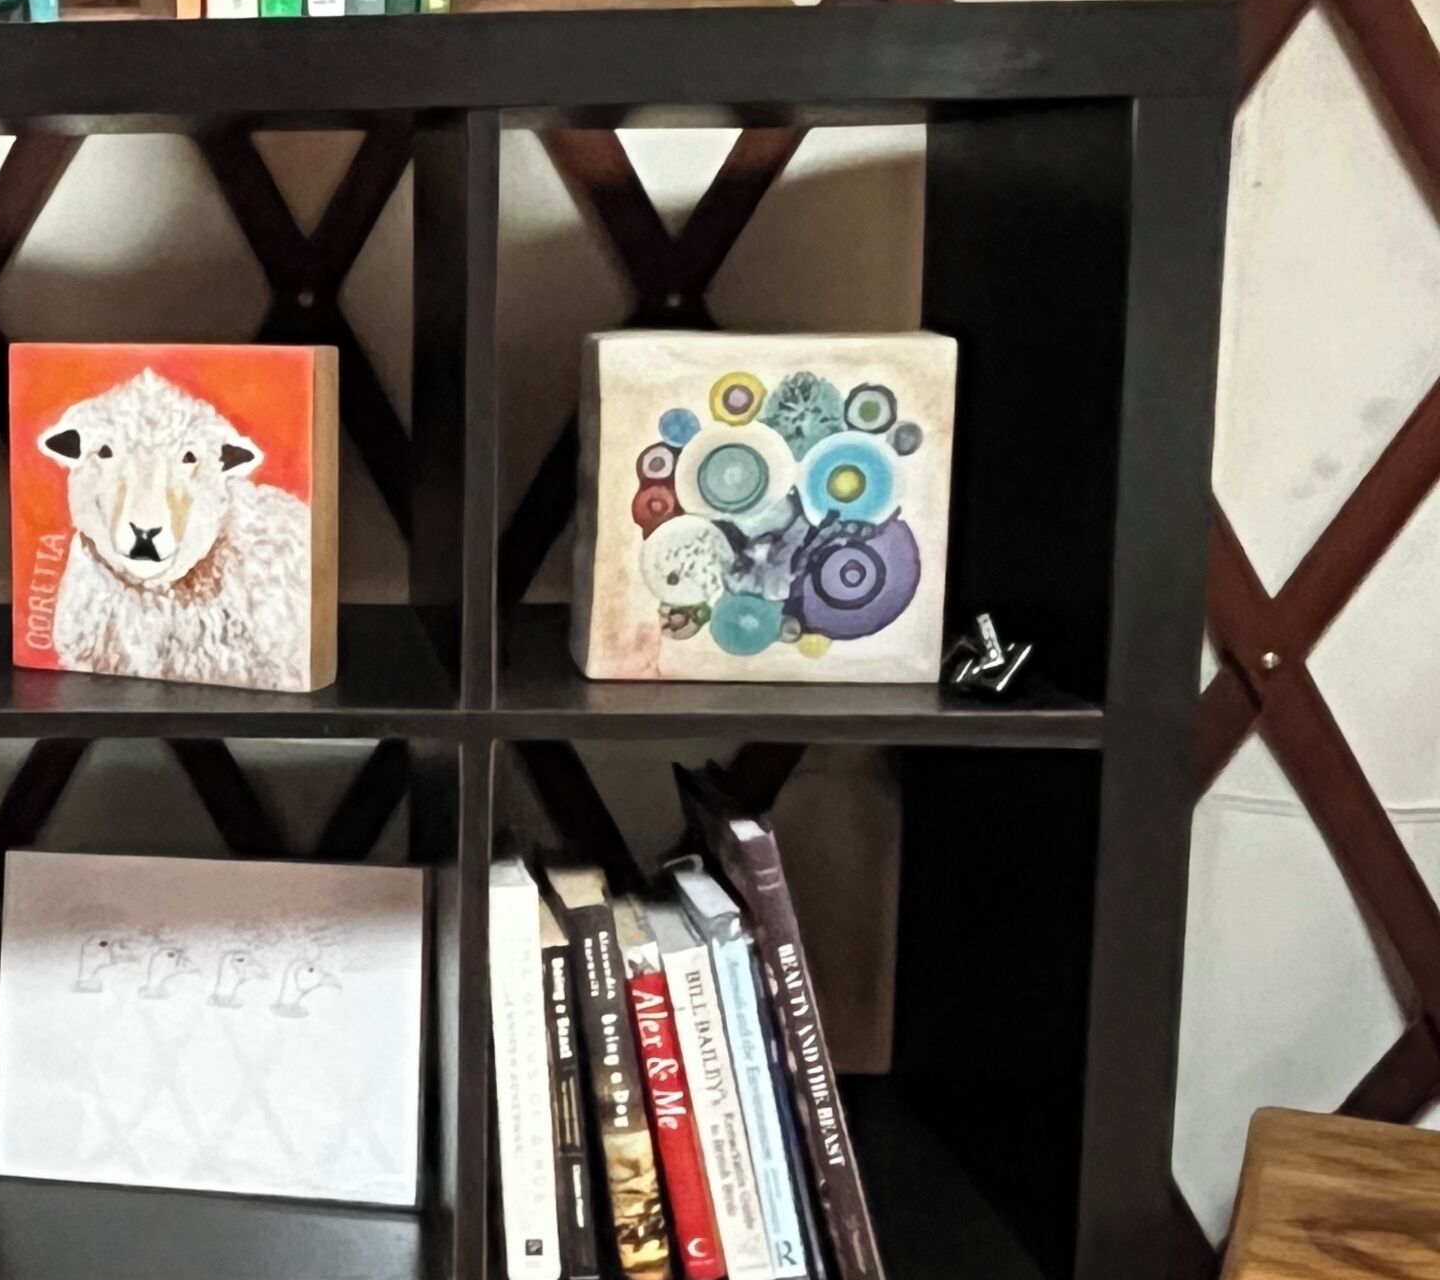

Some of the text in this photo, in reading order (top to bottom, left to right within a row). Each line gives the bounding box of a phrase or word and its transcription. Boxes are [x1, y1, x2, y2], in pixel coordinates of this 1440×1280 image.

[684, 969, 707, 1016] BILL
[646, 1052, 681, 1082] &
[776, 943, 844, 1168] BEAUTY AND THE BEAST
[650, 1084, 688, 1132] Me
